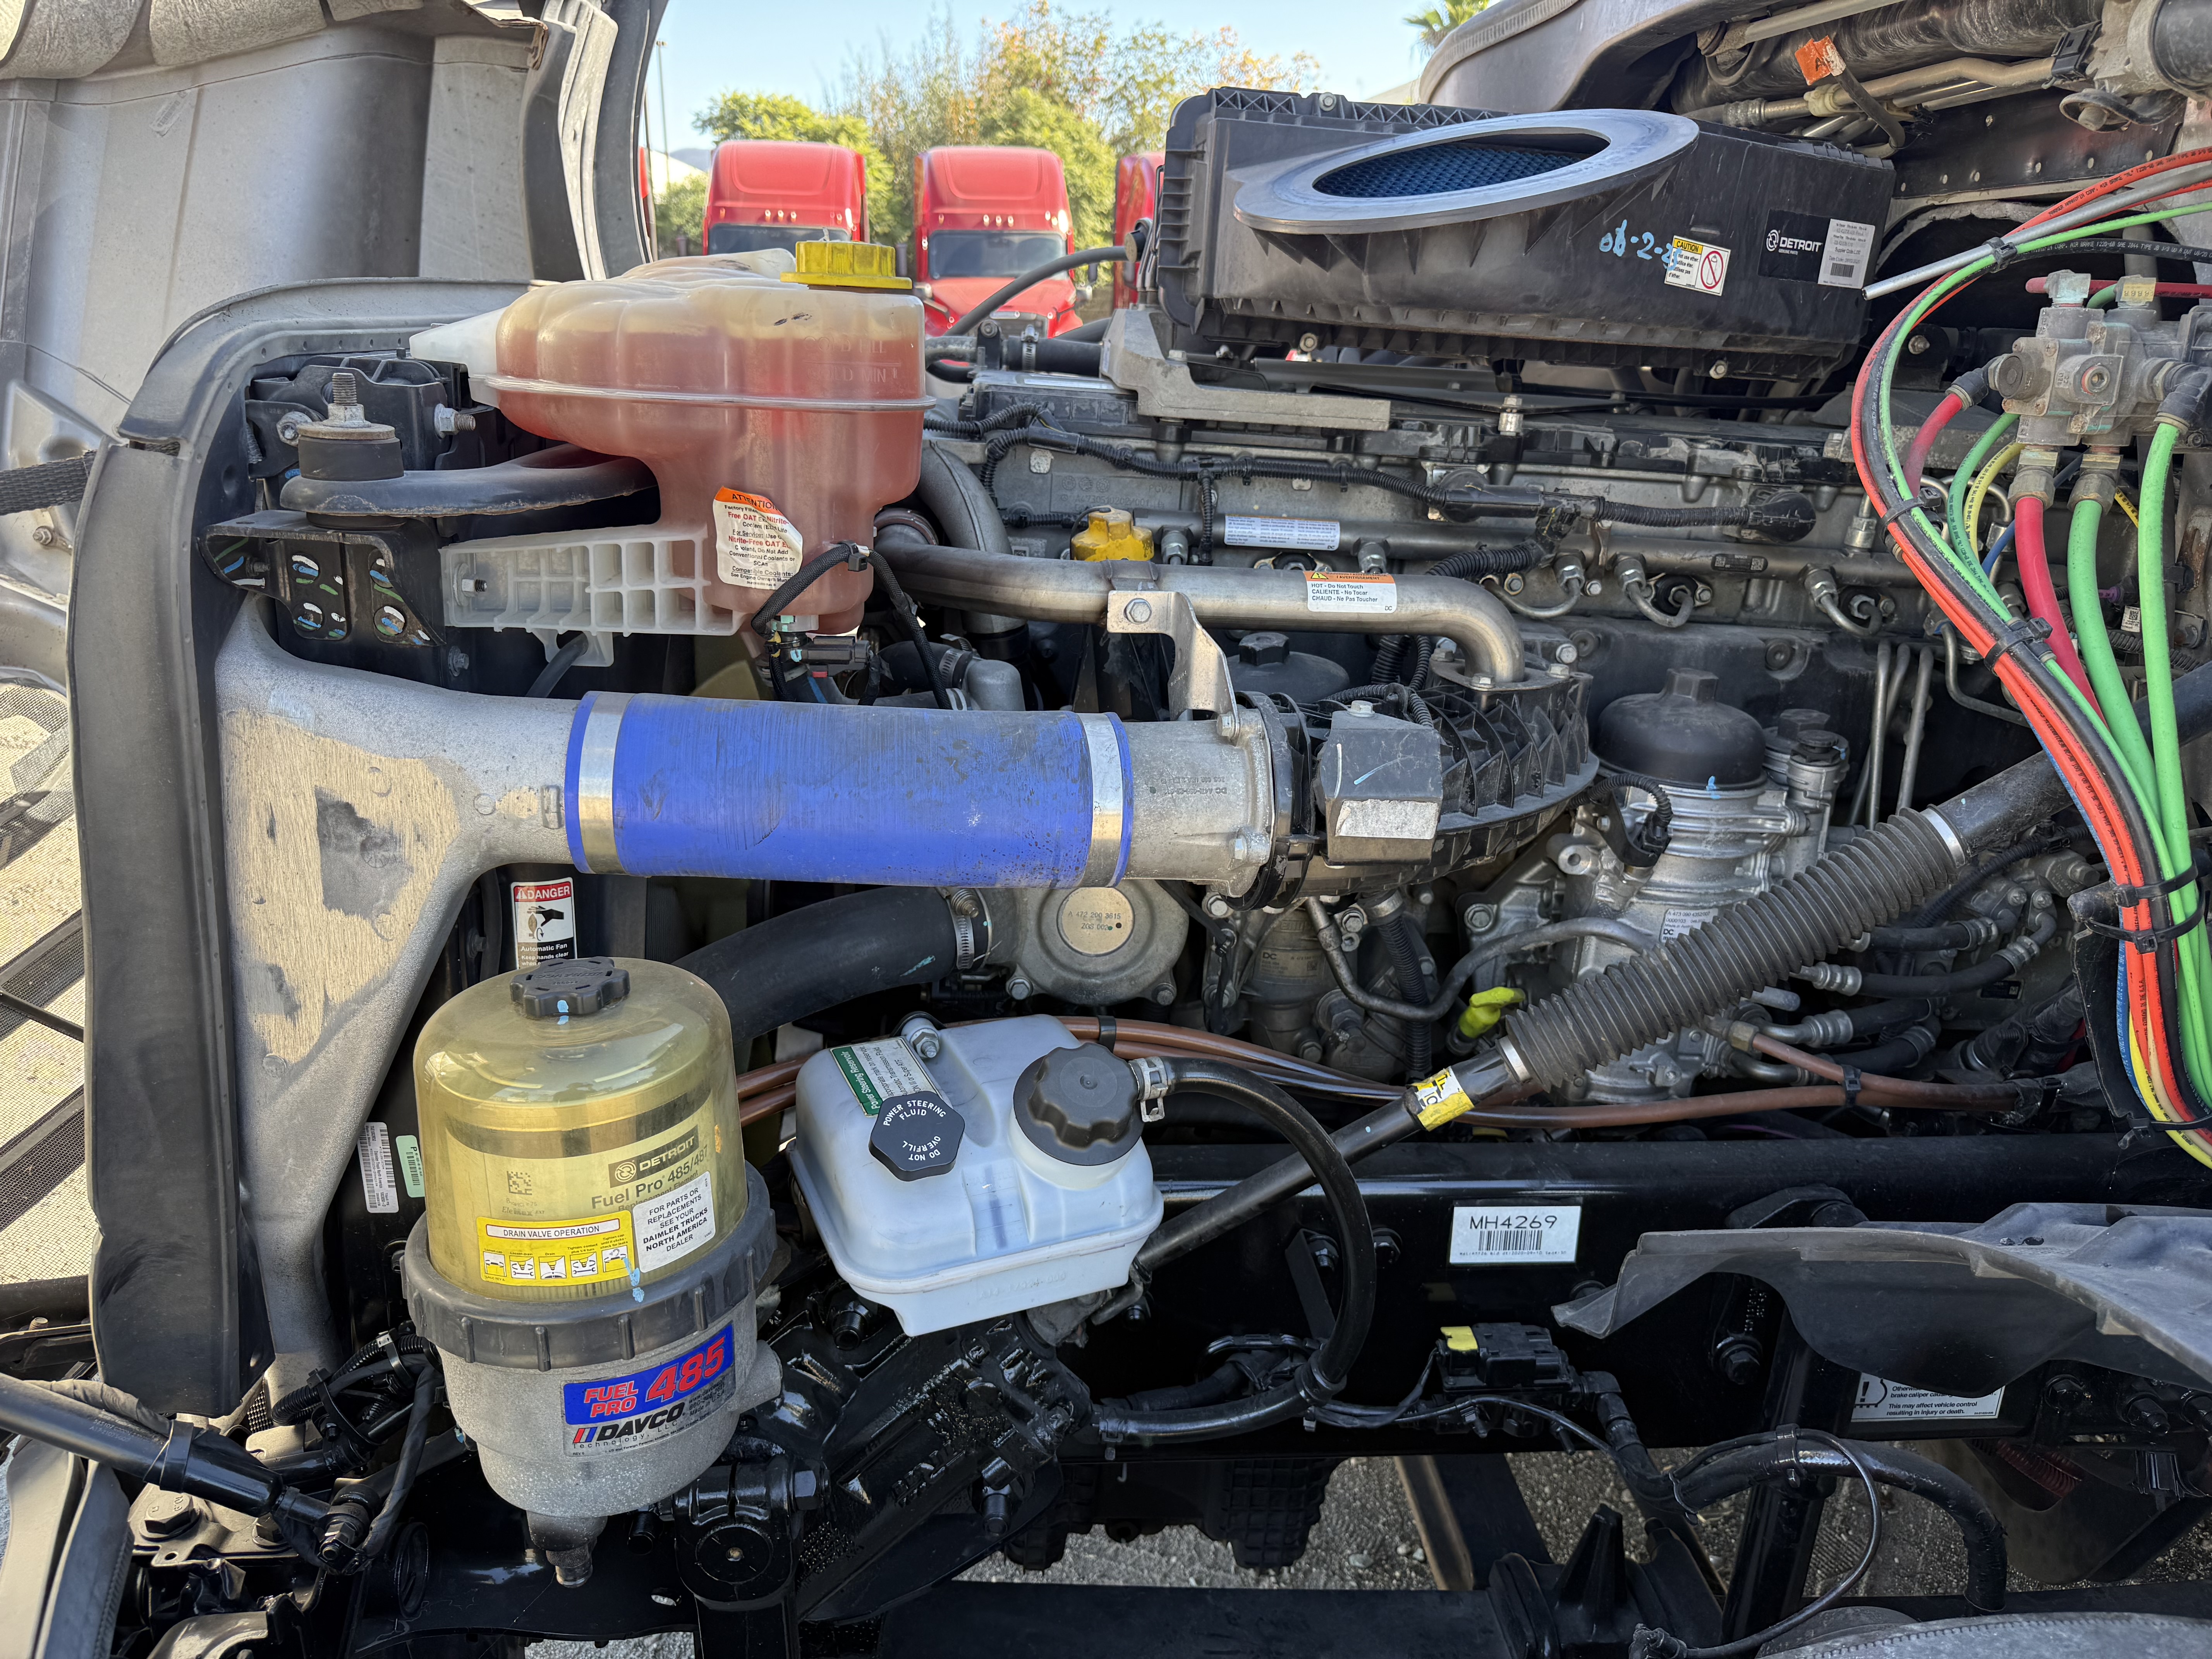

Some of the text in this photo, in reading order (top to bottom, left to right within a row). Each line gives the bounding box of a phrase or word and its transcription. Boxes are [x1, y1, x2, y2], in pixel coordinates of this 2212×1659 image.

[1676, 241, 1699, 252] CAUTION
[1779, 237, 1823, 252] DETROIT
[861, 368, 886, 383] MIN
[767, 516, 789, 525] Nitrite-
[728, 536, 763, 546] Nitrite-Free
[729, 551, 763, 559] Conventional
[732, 566, 763, 574] Compatible
[527, 886, 570, 899] DANGER
[872, 1045, 897, 1080] Transmission Fluid
[900, 1064, 912, 1078] Super
[842, 1051, 881, 1109] Power Steering Reservoir
[871, 1066, 881, 1077] mark
[876, 1074, 895, 1098] appropriate
[883, 1100, 946, 1126] POWER STEERING
[899, 1109, 927, 1120] FLUID
[902, 1135, 941, 1152] OVERFILL
[639, 1135, 694, 1171] DETROIT
[929, 1149, 941, 1158] DO
[673, 1170, 699, 1190] Element
[591, 1188, 629, 1209] Fuel
[636, 1180, 663, 1197] Pro
[649, 1187, 699, 1216] FOR PARTS OR
[647, 1194, 702, 1225] REPLACEMENTS
[643, 1207, 708, 1244] DAIMLER TRUCKS
[660, 1208, 694, 1229] SEE YOUR
[1470, 1215, 1558, 1229] MH4269
[554, 1226, 599, 1237] OPERATION
[646, 1217, 707, 1251] NORTH AMERICA
[666, 1234, 693, 1252] DEALER
[646, 1336, 726, 1403] 485
[584, 1380, 638, 1403] FUEL
[590, 1396, 637, 1418] PRO
[690, 1405, 704, 1416] Made
[596, 1402, 685, 1441] DAVCO
[572, 1433, 649, 1449] Technology,
